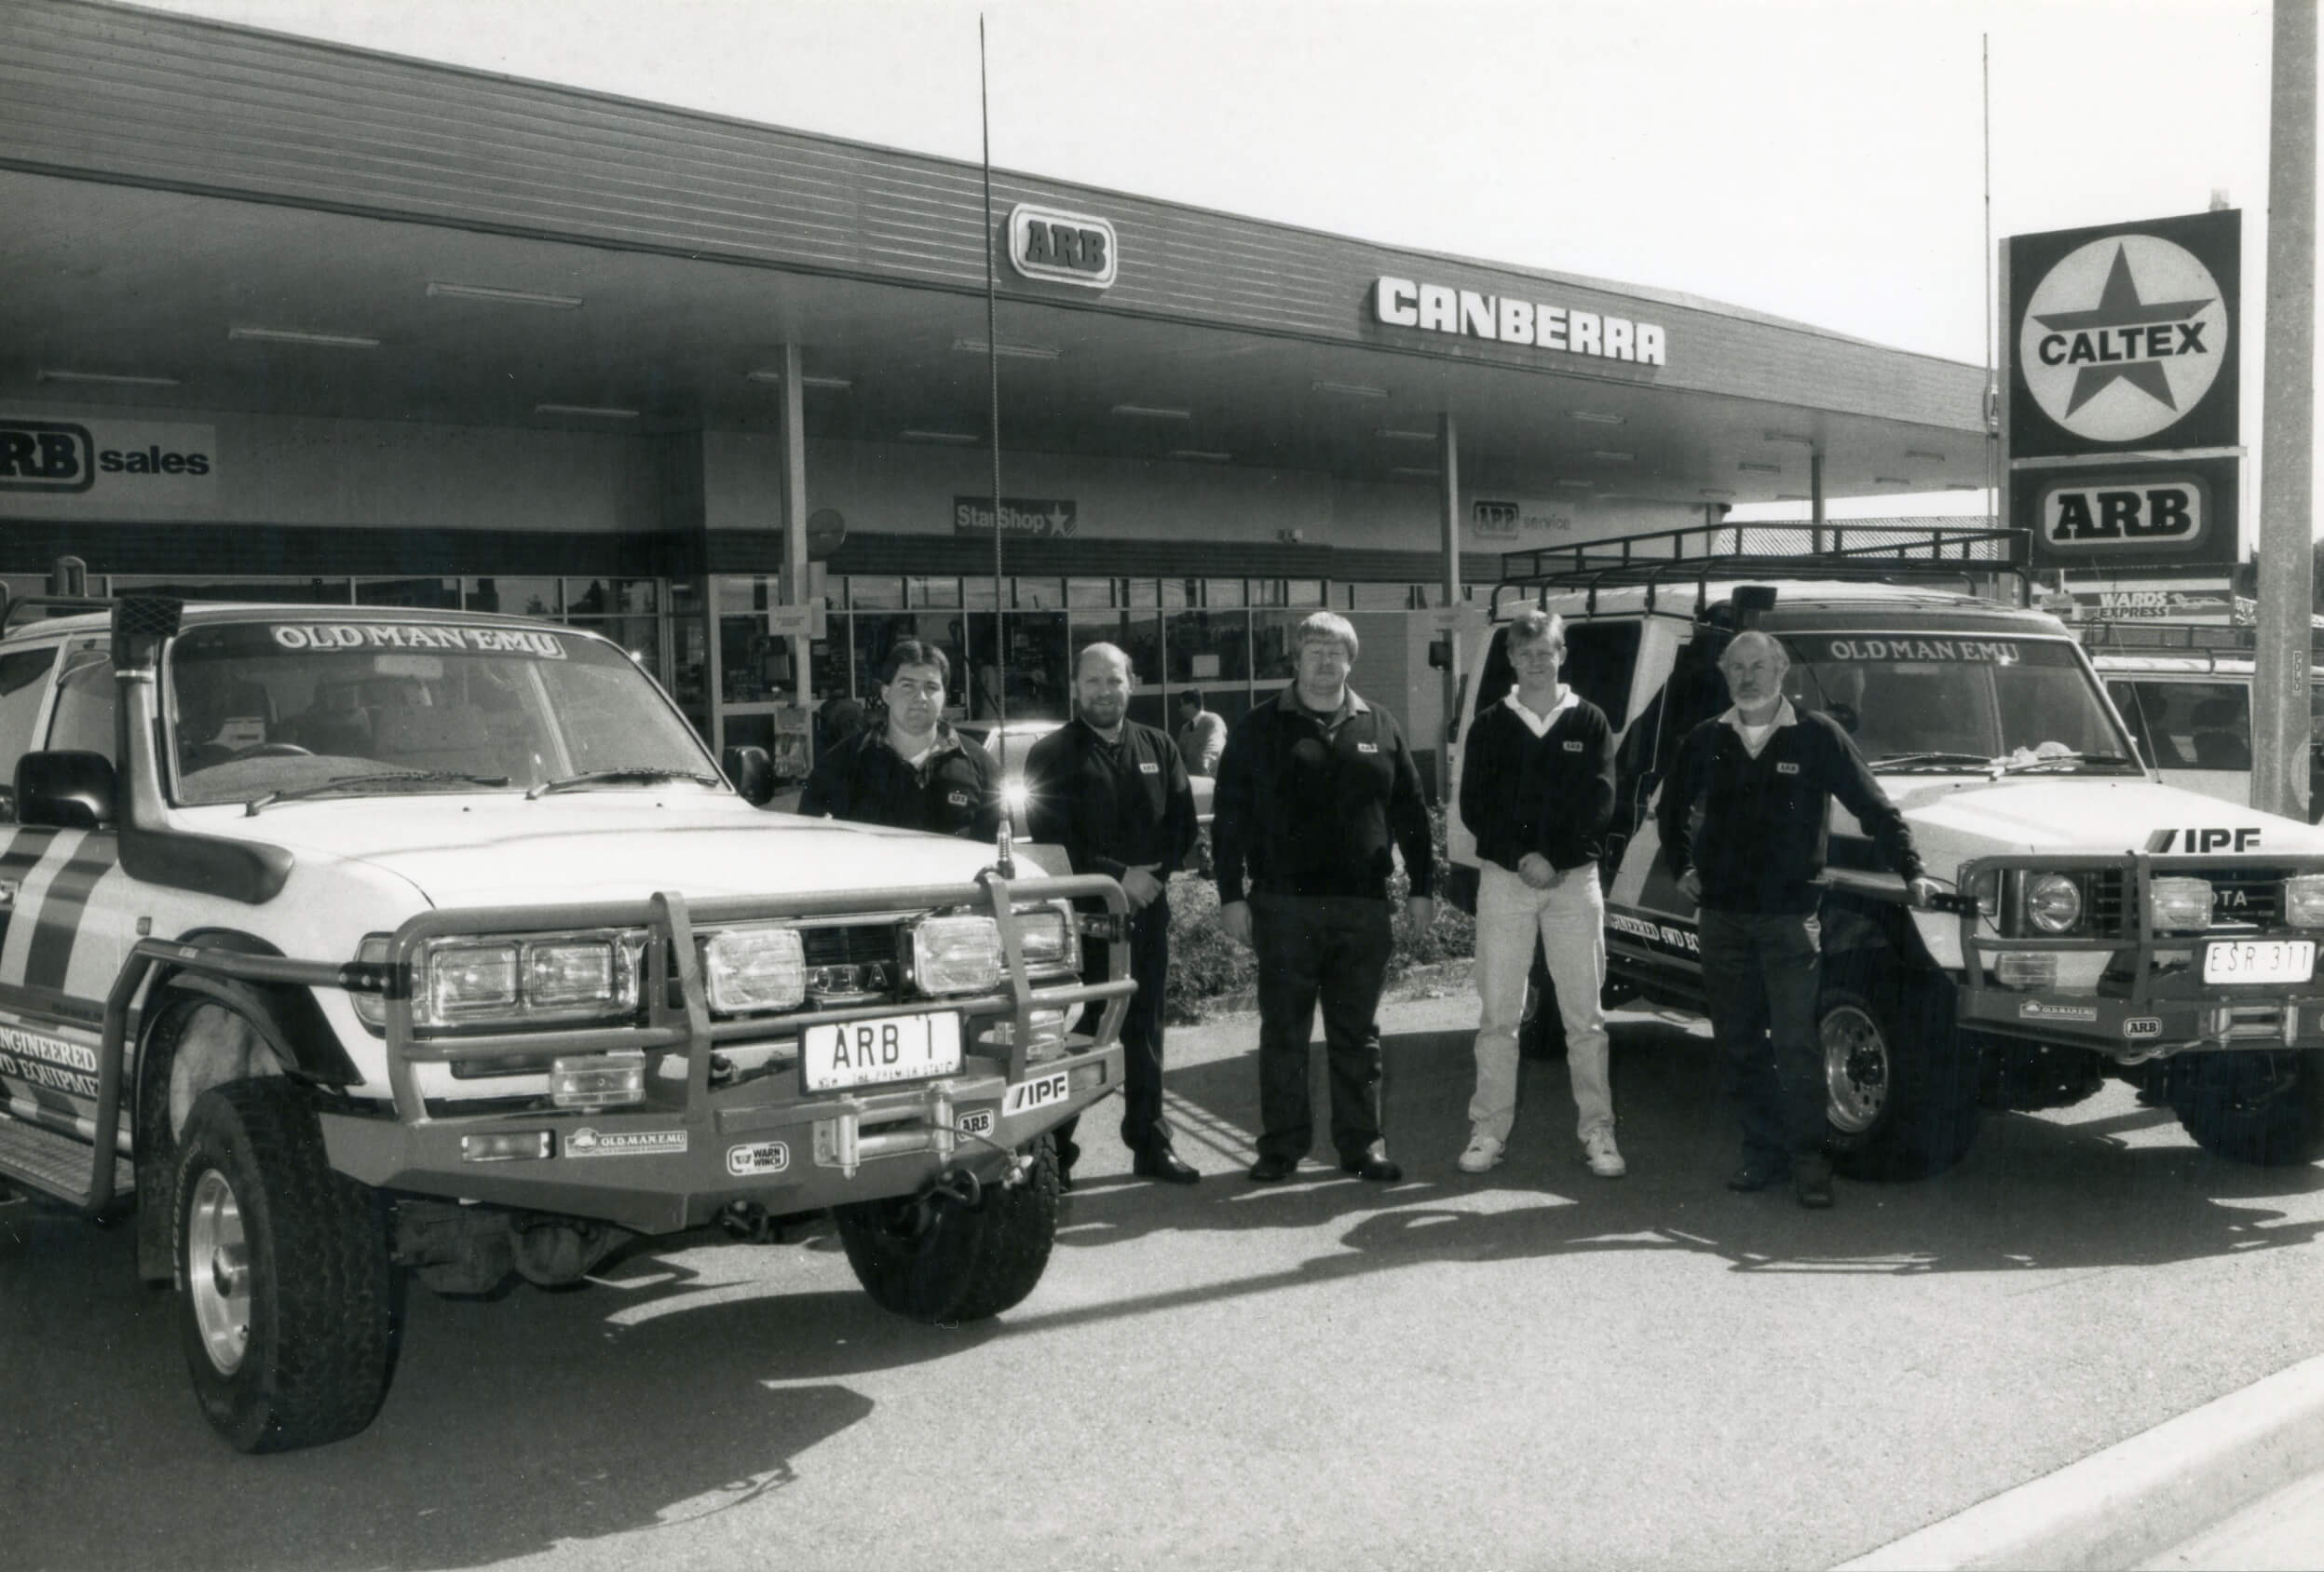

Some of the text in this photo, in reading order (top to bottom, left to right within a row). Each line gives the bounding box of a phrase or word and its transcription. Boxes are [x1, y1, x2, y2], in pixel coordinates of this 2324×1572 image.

[1025, 219, 1107, 272] ARB
[1378, 276, 1665, 365] CANBERRA
[2038, 321, 2208, 366] CALTEX
[99, 444, 210, 476] sales
[2052, 488, 2193, 540] ARB
[2099, 606, 2168, 618] EXPRESS
[275, 626, 563, 657] OLD MAN EMU
[1830, 640, 2020, 663] OLD MAN EMU
[2210, 945, 2307, 972] ESR 311
[2128, 1022, 2157, 1034] ARB
[833, 1023, 899, 1070] ARB
[962, 1115, 990, 1133] ARB
[600, 1132, 686, 1147] OLD MAN EMU
[753, 1147, 781, 1158] WARN
[753, 1158, 781, 1167] WINCH
